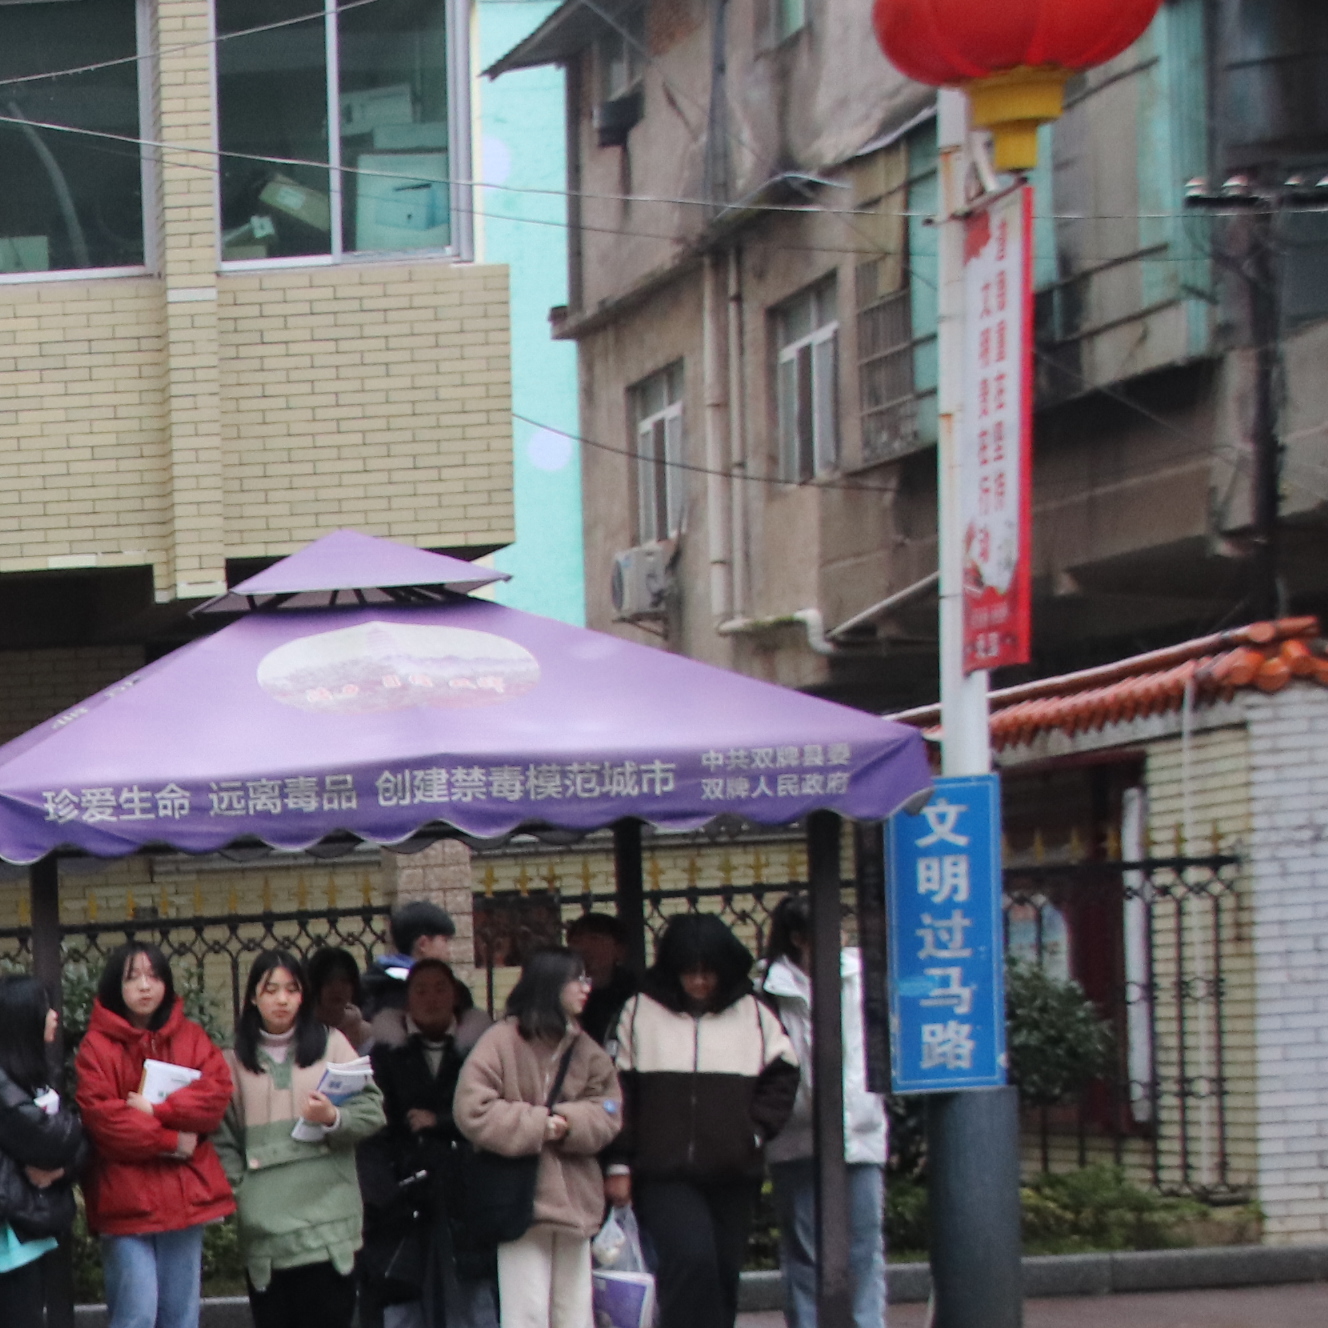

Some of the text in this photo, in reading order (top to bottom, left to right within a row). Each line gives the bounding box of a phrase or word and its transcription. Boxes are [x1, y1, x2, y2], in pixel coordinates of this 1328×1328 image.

[700, 743, 851, 771] 中共双牌县委
[43, 758, 677, 824] 珍爱生命 远离毒品 创建禁毒模范城市
[700, 771, 851, 801] 双牌人民政府
[914, 797, 975, 1070] 文明过马路
